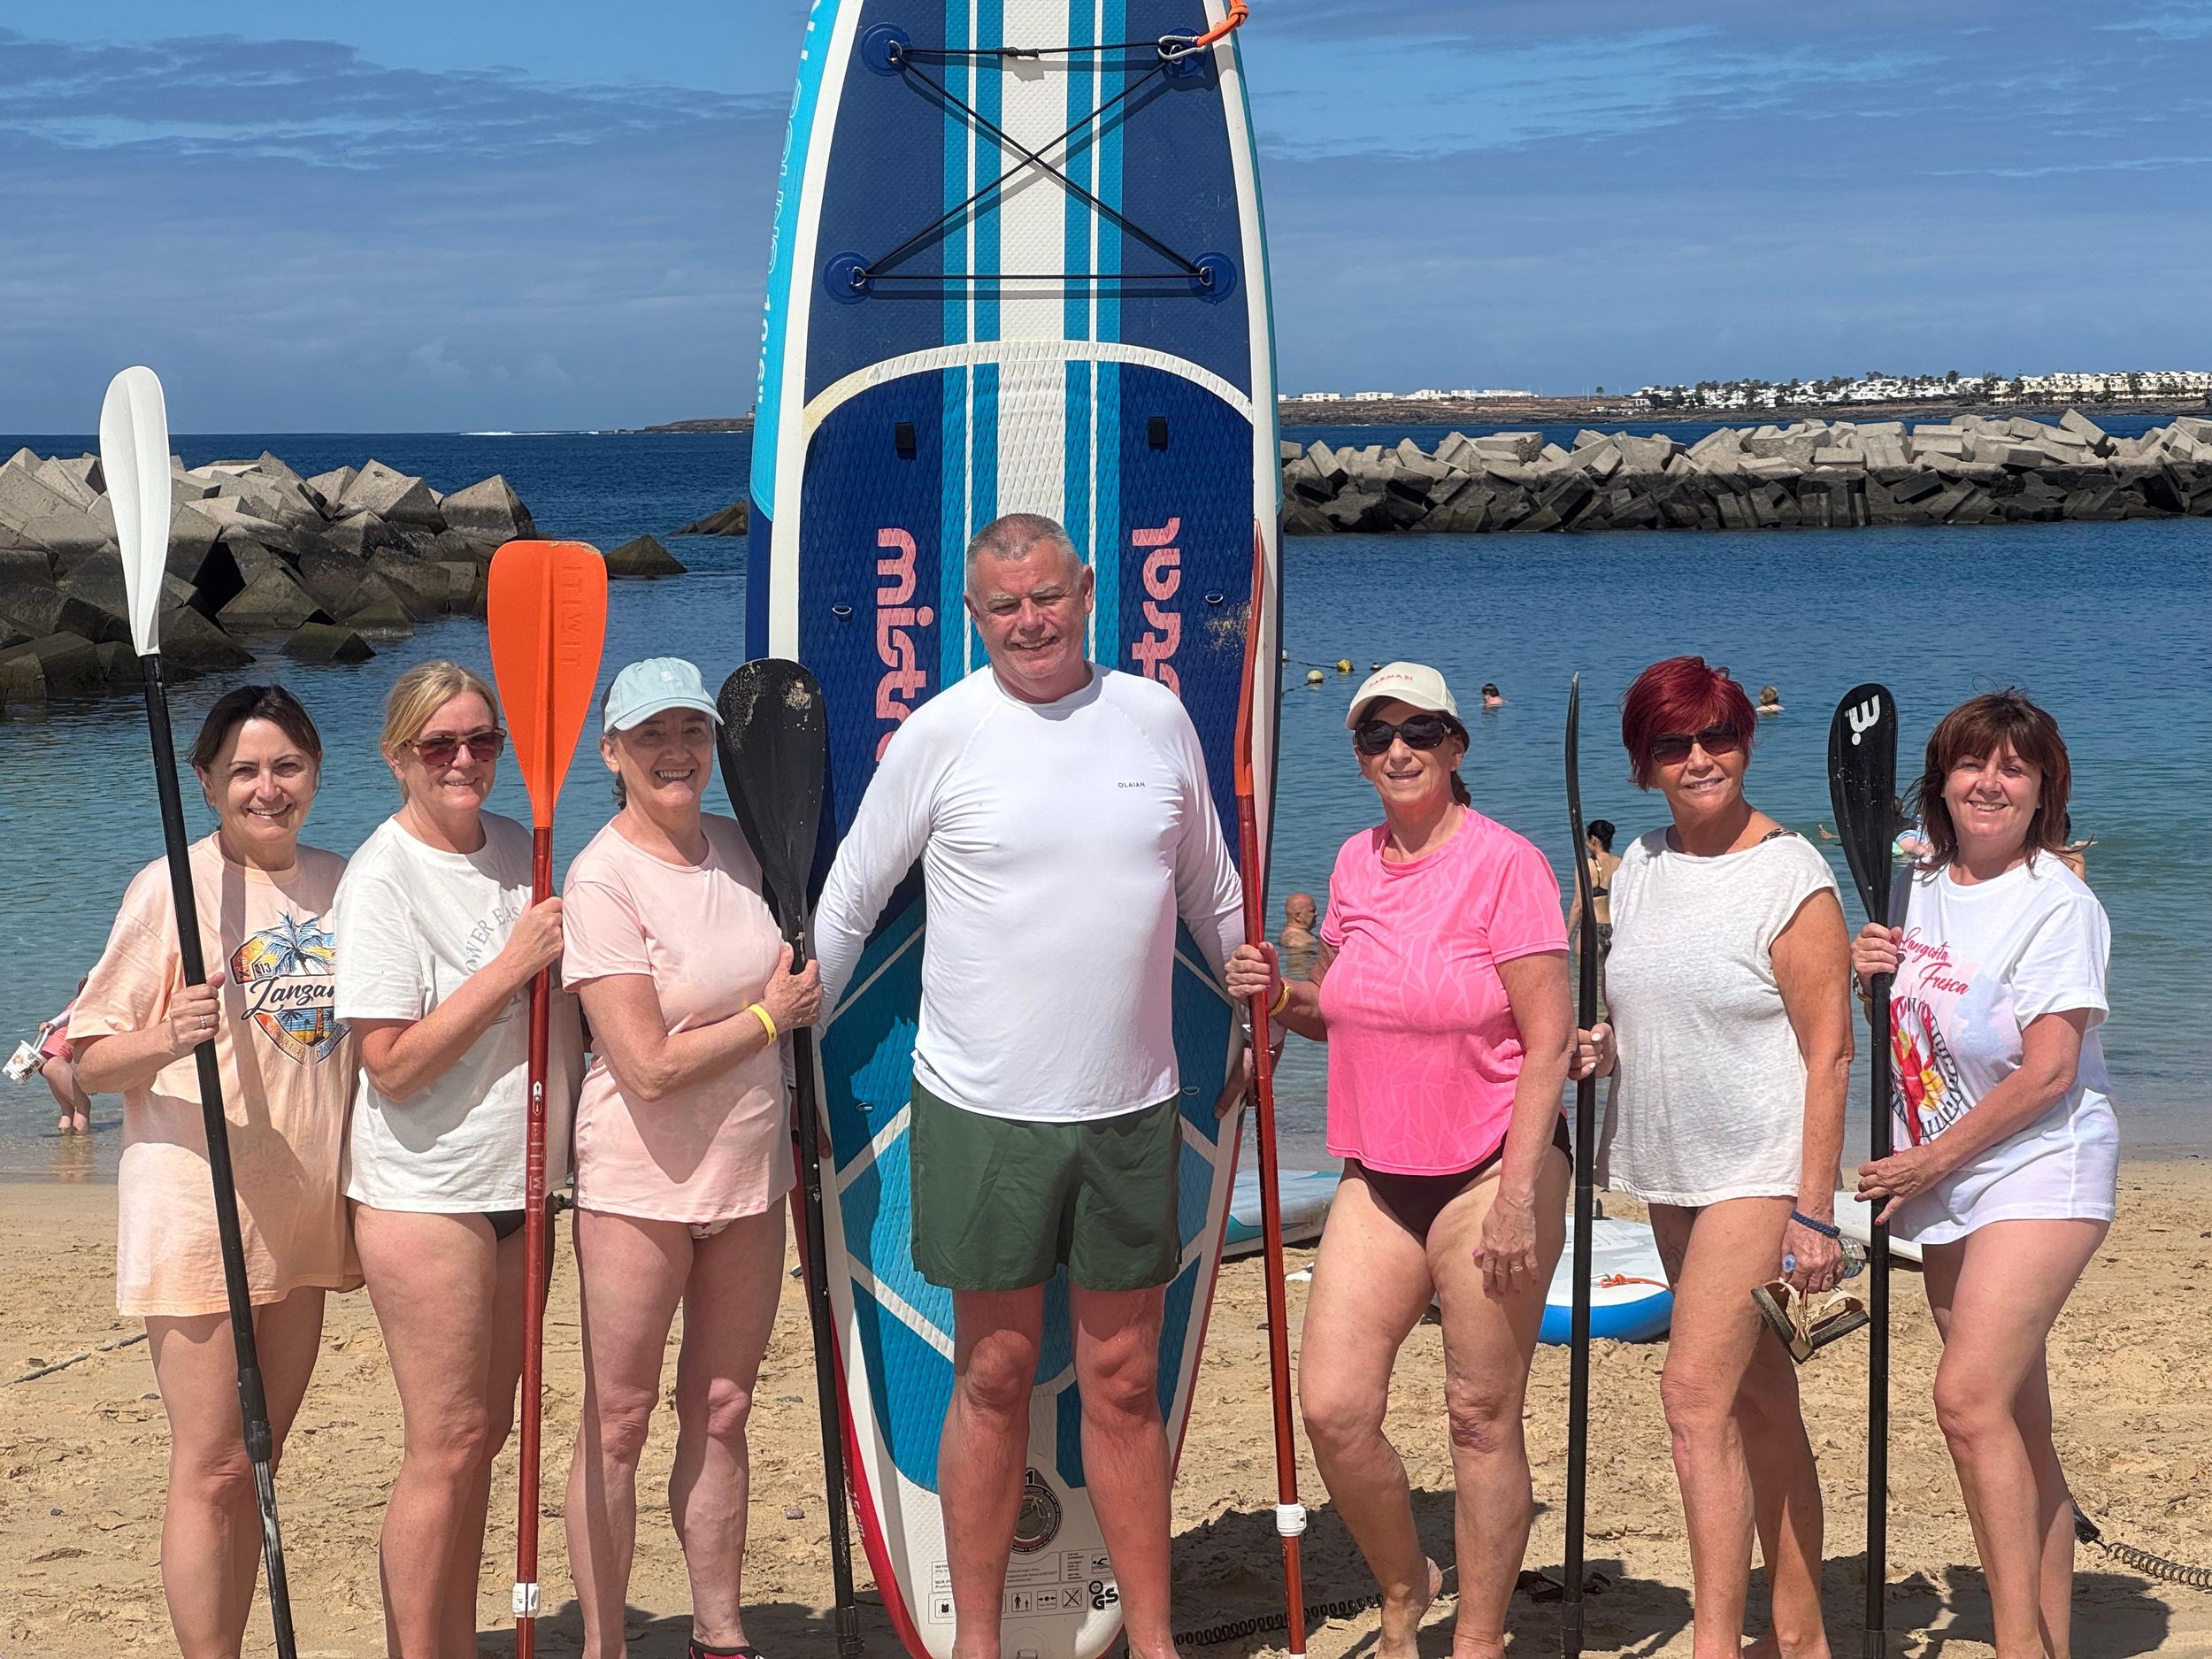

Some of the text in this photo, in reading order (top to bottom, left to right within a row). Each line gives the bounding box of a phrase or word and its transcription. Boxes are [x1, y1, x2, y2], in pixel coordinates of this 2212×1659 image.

[1132, 517, 1181, 699] stral
[875, 528, 934, 762] mistr
[465, 906, 521, 973] OWER EAS
[241, 976, 334, 1020] Lanzar
[1919, 962, 1971, 995] Fresca
